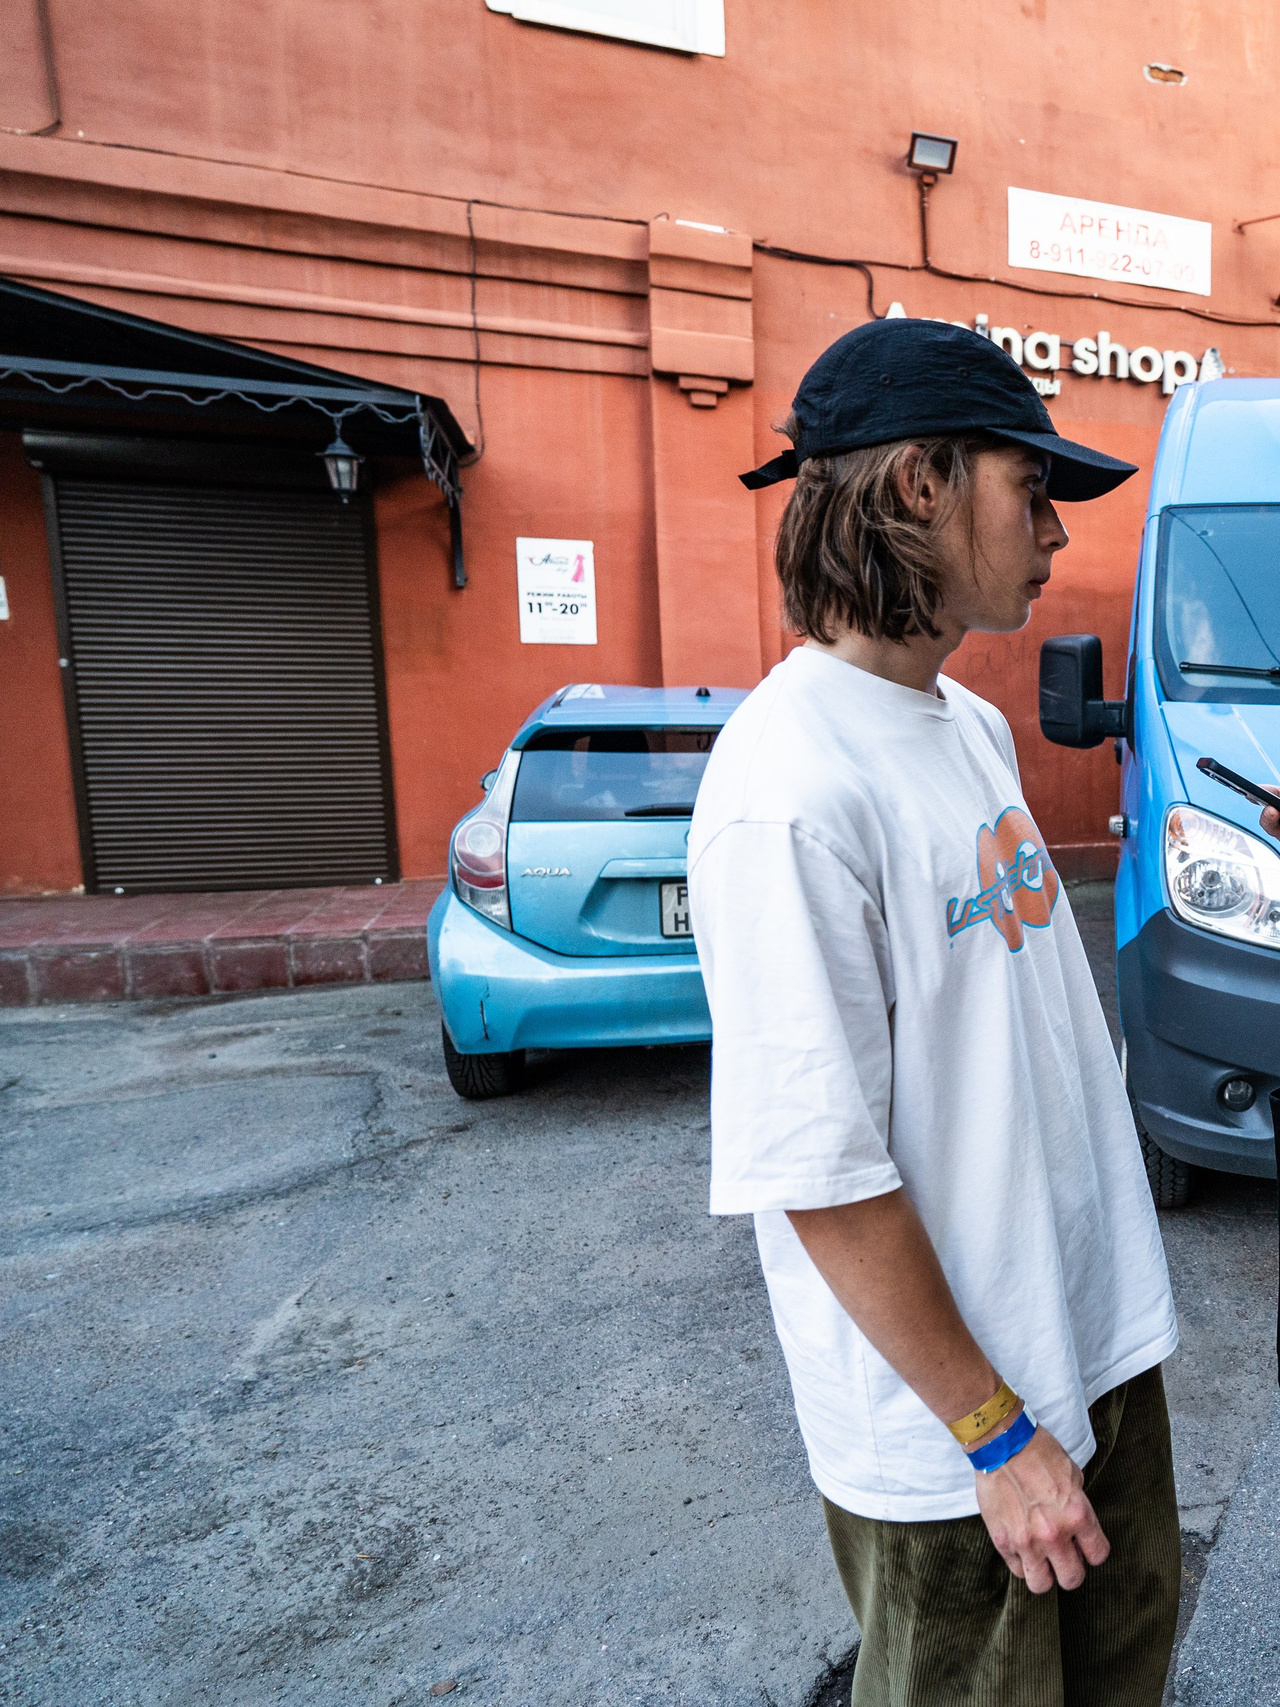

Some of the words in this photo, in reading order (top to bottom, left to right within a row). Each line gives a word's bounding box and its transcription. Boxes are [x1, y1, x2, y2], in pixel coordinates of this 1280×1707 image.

[1059, 212, 1169, 251] АРЕНДА
[1072, 330, 1199, 395] shop
[521, 867, 572, 877] AQUA
